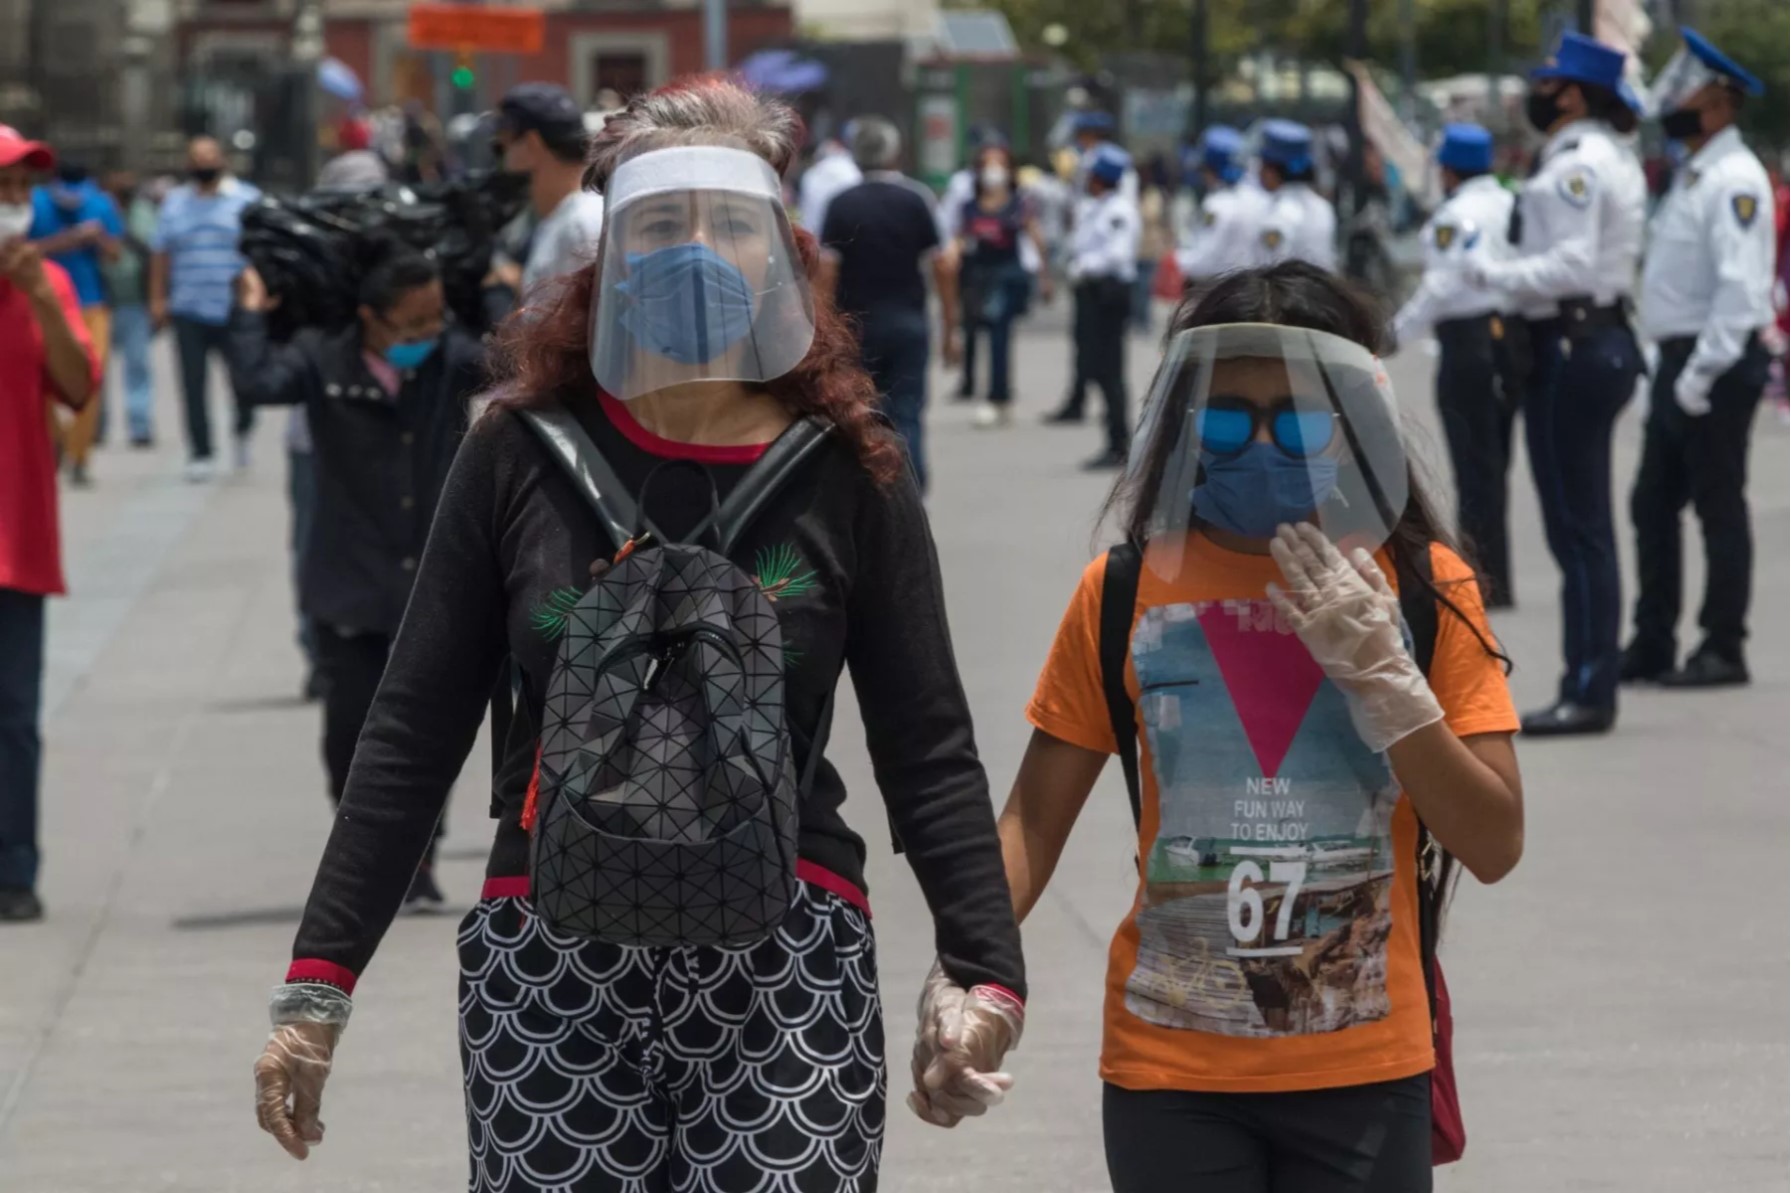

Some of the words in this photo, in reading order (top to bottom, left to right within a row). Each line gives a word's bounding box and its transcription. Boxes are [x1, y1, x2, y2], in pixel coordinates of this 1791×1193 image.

[1246, 776, 1291, 795] NEW
[1234, 800, 1267, 818] FUN
[1270, 800, 1306, 818] WAY
[1230, 822, 1251, 840] TO
[1256, 822, 1309, 841] ENJOY
[1227, 860, 1307, 942] 67
